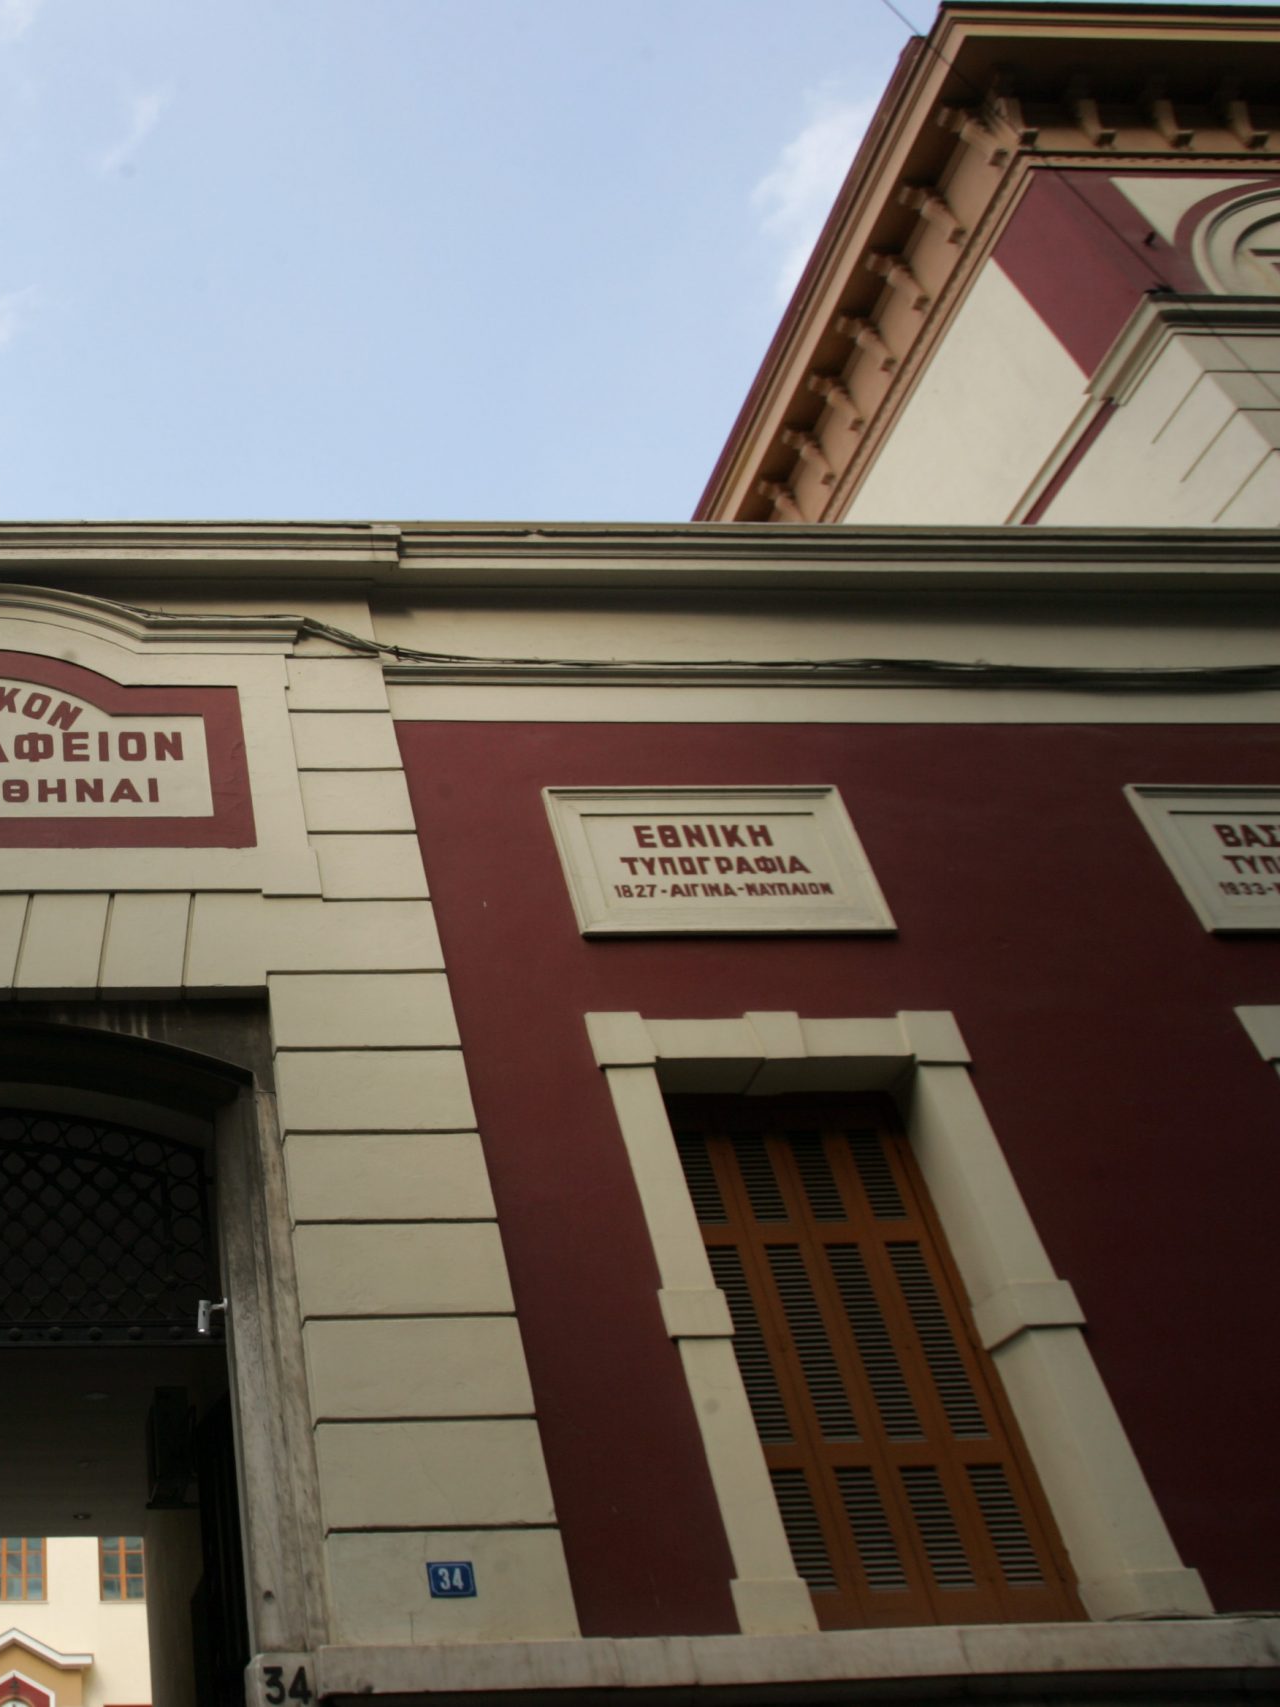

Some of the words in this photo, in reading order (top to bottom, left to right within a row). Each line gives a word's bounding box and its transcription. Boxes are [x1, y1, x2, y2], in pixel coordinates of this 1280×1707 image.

[633, 824, 774, 848] ΕΘΝΙΚΗ
[1212, 824, 1280, 848] ΒΑΣ
[620, 855, 811, 875] ΤΥΠΟΓΡΑΦΙΑ
[1222, 855, 1280, 874] ΤΥΠ
[438, 1568, 464, 1590] 34
[263, 1666, 313, 1705] 34
